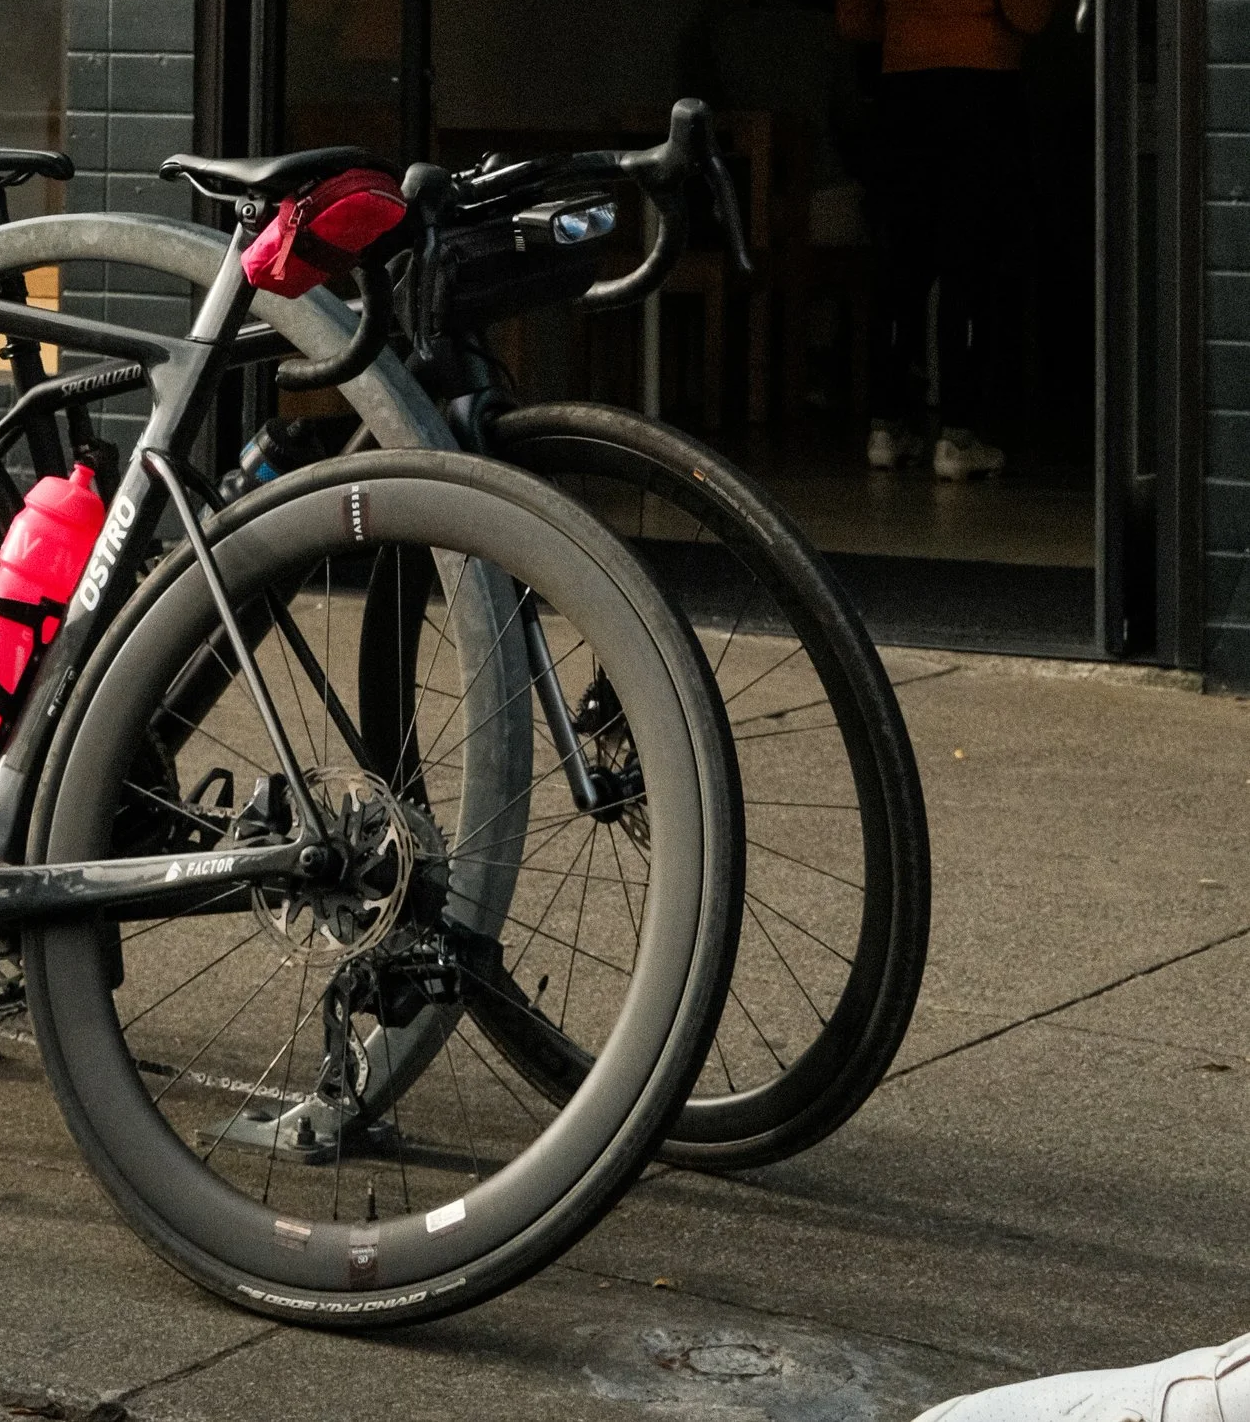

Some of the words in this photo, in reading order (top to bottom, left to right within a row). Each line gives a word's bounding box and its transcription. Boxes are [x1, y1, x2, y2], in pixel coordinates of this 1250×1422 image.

[61, 363, 141, 397] SPECIALIZED
[351, 484, 365, 542] RESERVE
[79, 494, 137, 613] OSTRO
[186, 857, 235, 878] FACTOR
[263, 1294, 317, 1311] 5000
[317, 1302, 365, 1313] PRIX
